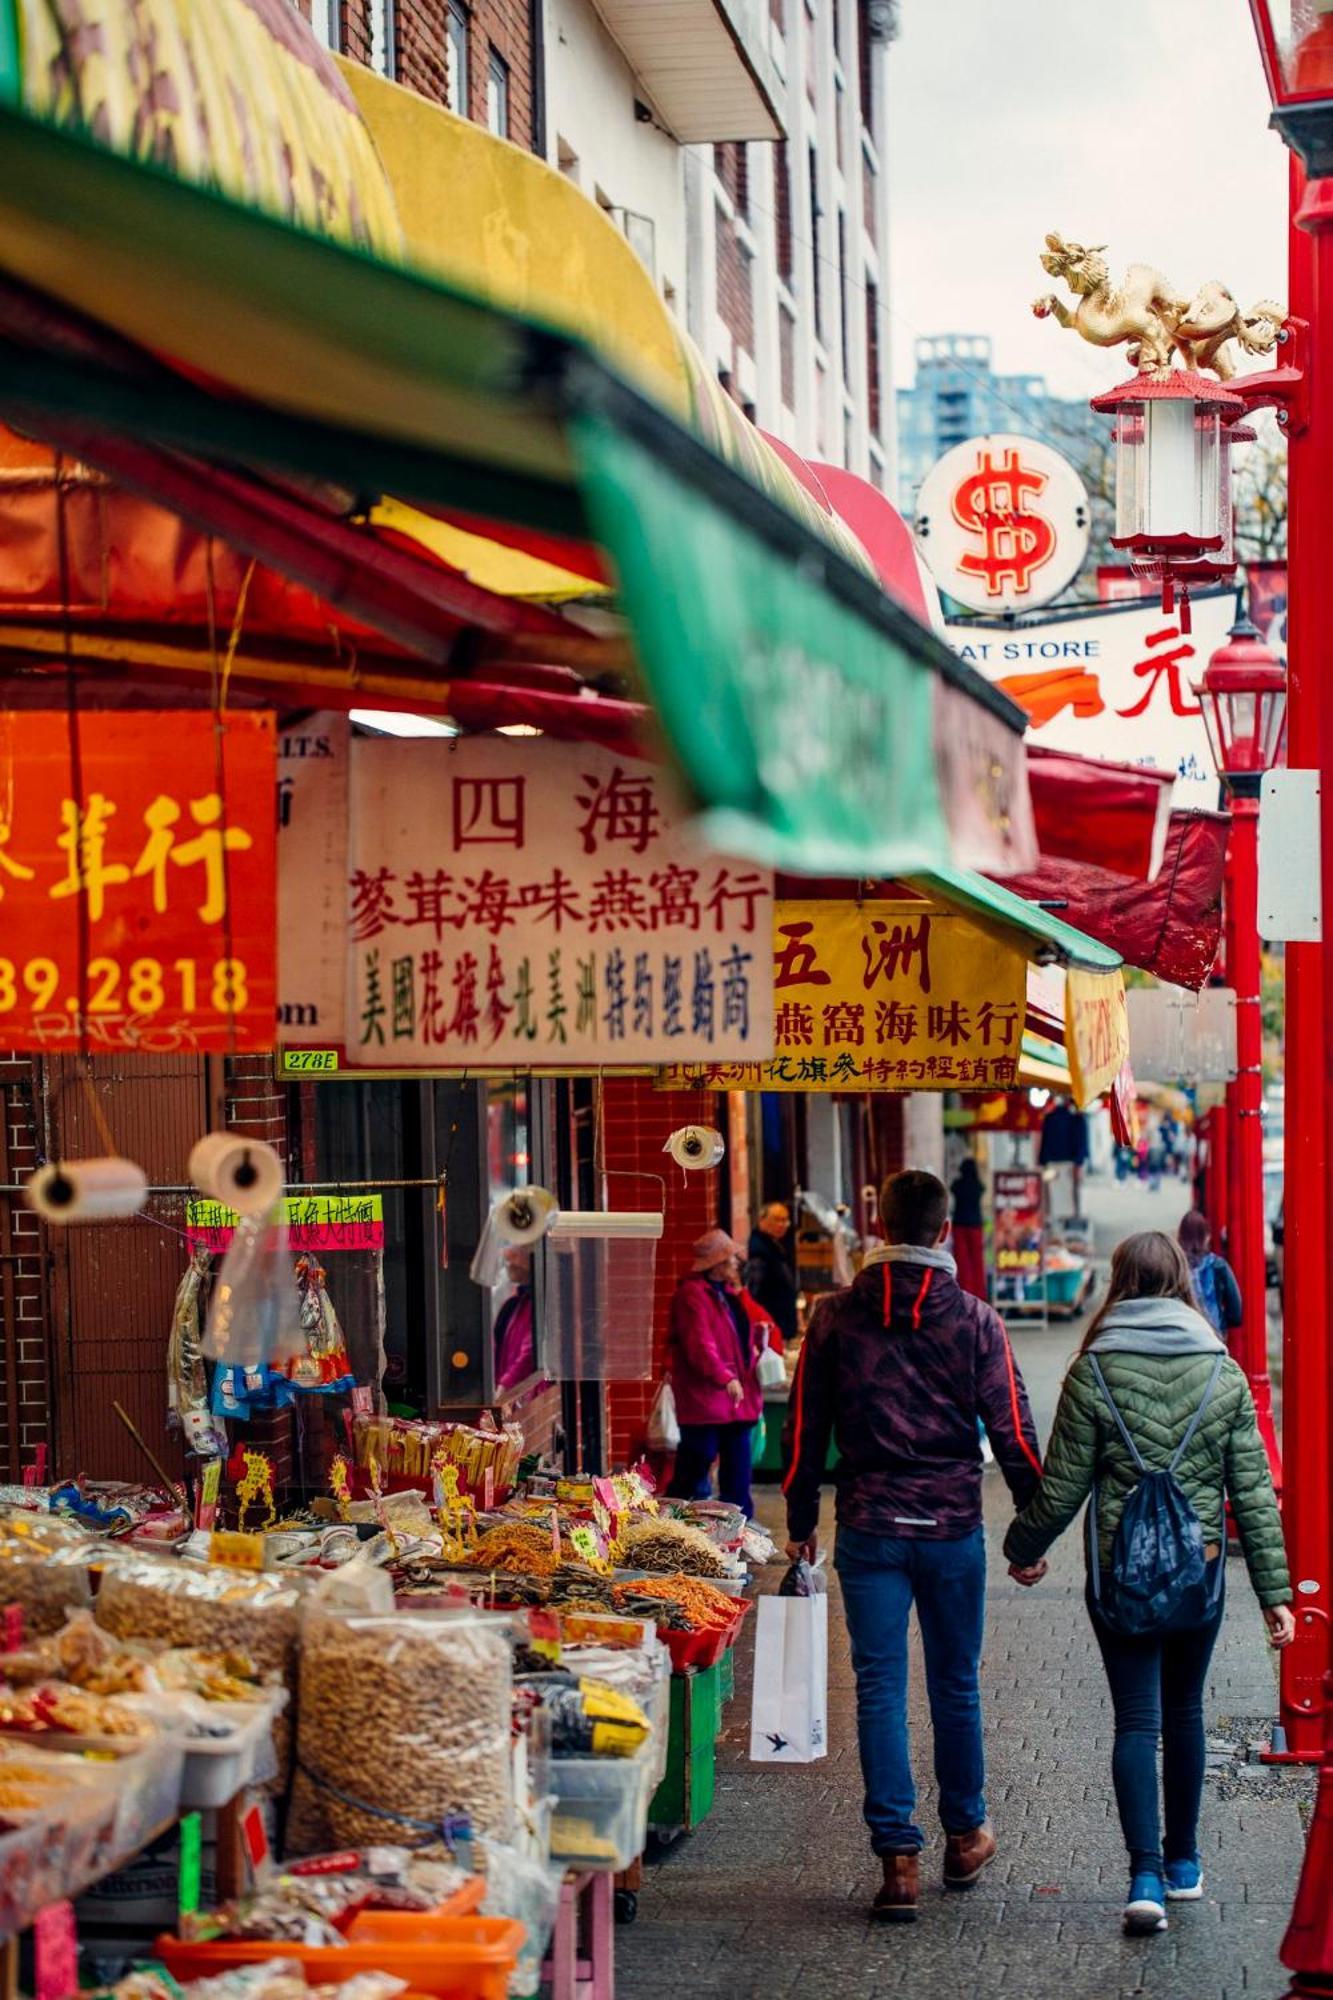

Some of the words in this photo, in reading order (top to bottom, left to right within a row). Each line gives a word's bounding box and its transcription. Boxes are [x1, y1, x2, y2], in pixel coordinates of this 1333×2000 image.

[1003, 641, 1100, 659] STORE
[1115, 627, 1202, 718] 元
[451, 766, 660, 855] 四海
[775, 914, 931, 995] 五洲
[774, 1000, 1019, 1047] 燕窩海味行
[288, 1052, 335, 1069] 278E
